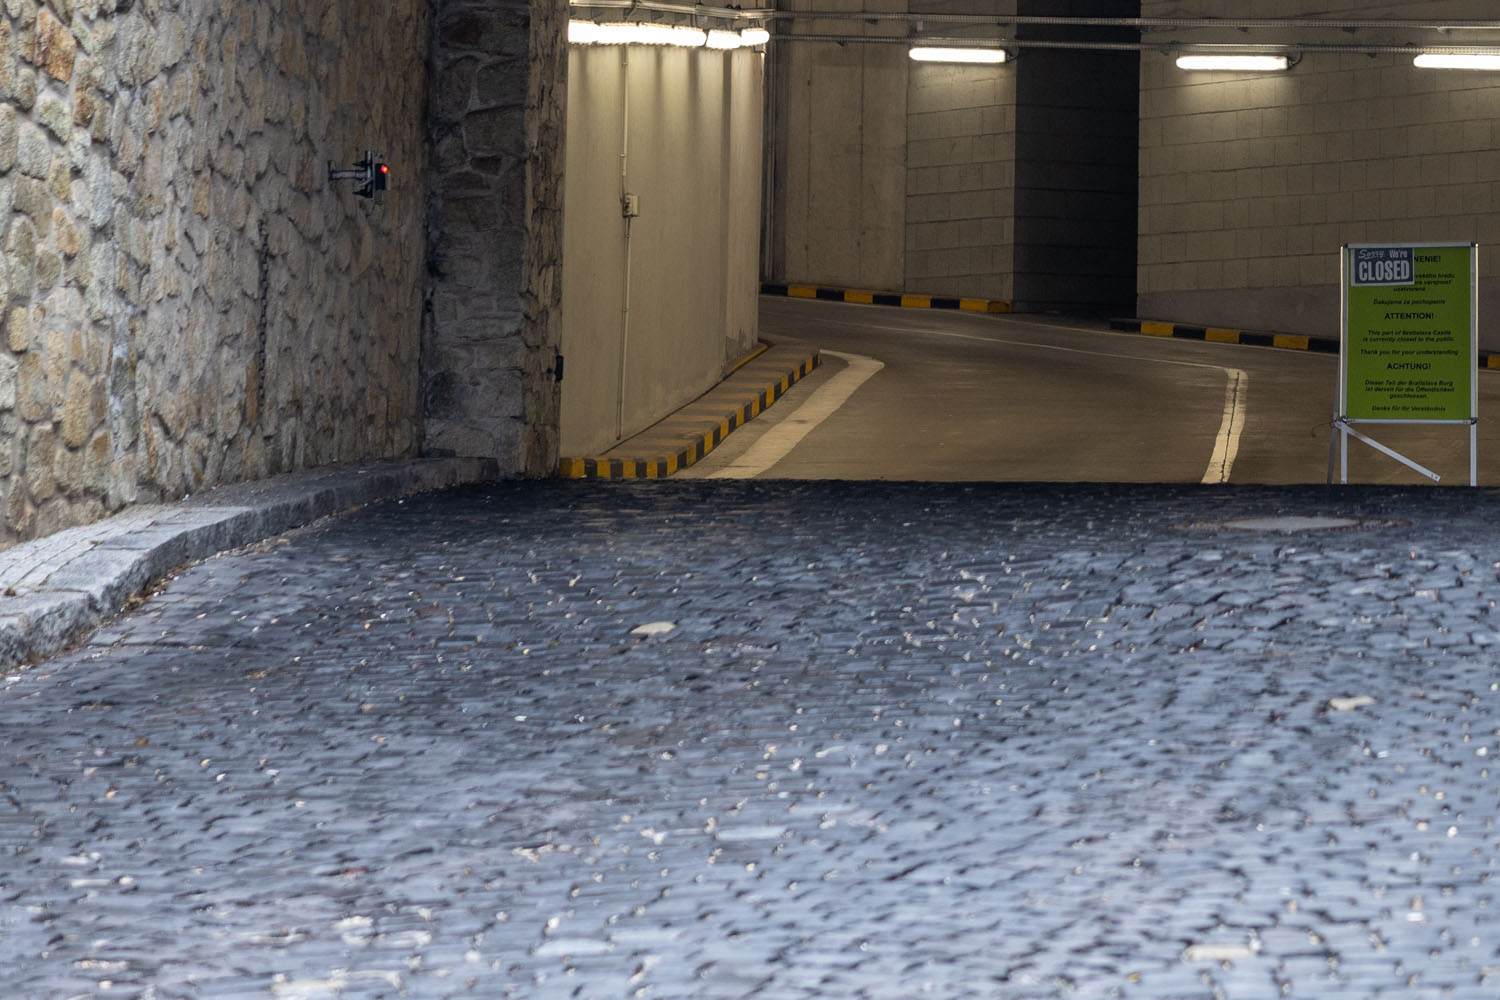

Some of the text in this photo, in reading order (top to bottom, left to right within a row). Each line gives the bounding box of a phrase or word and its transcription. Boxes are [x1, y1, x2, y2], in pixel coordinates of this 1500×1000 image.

[1358, 260, 1410, 281] CLOSED
[1384, 312, 1434, 320] ATTENTION!
[1387, 362, 1431, 370] ACHTUNG!
